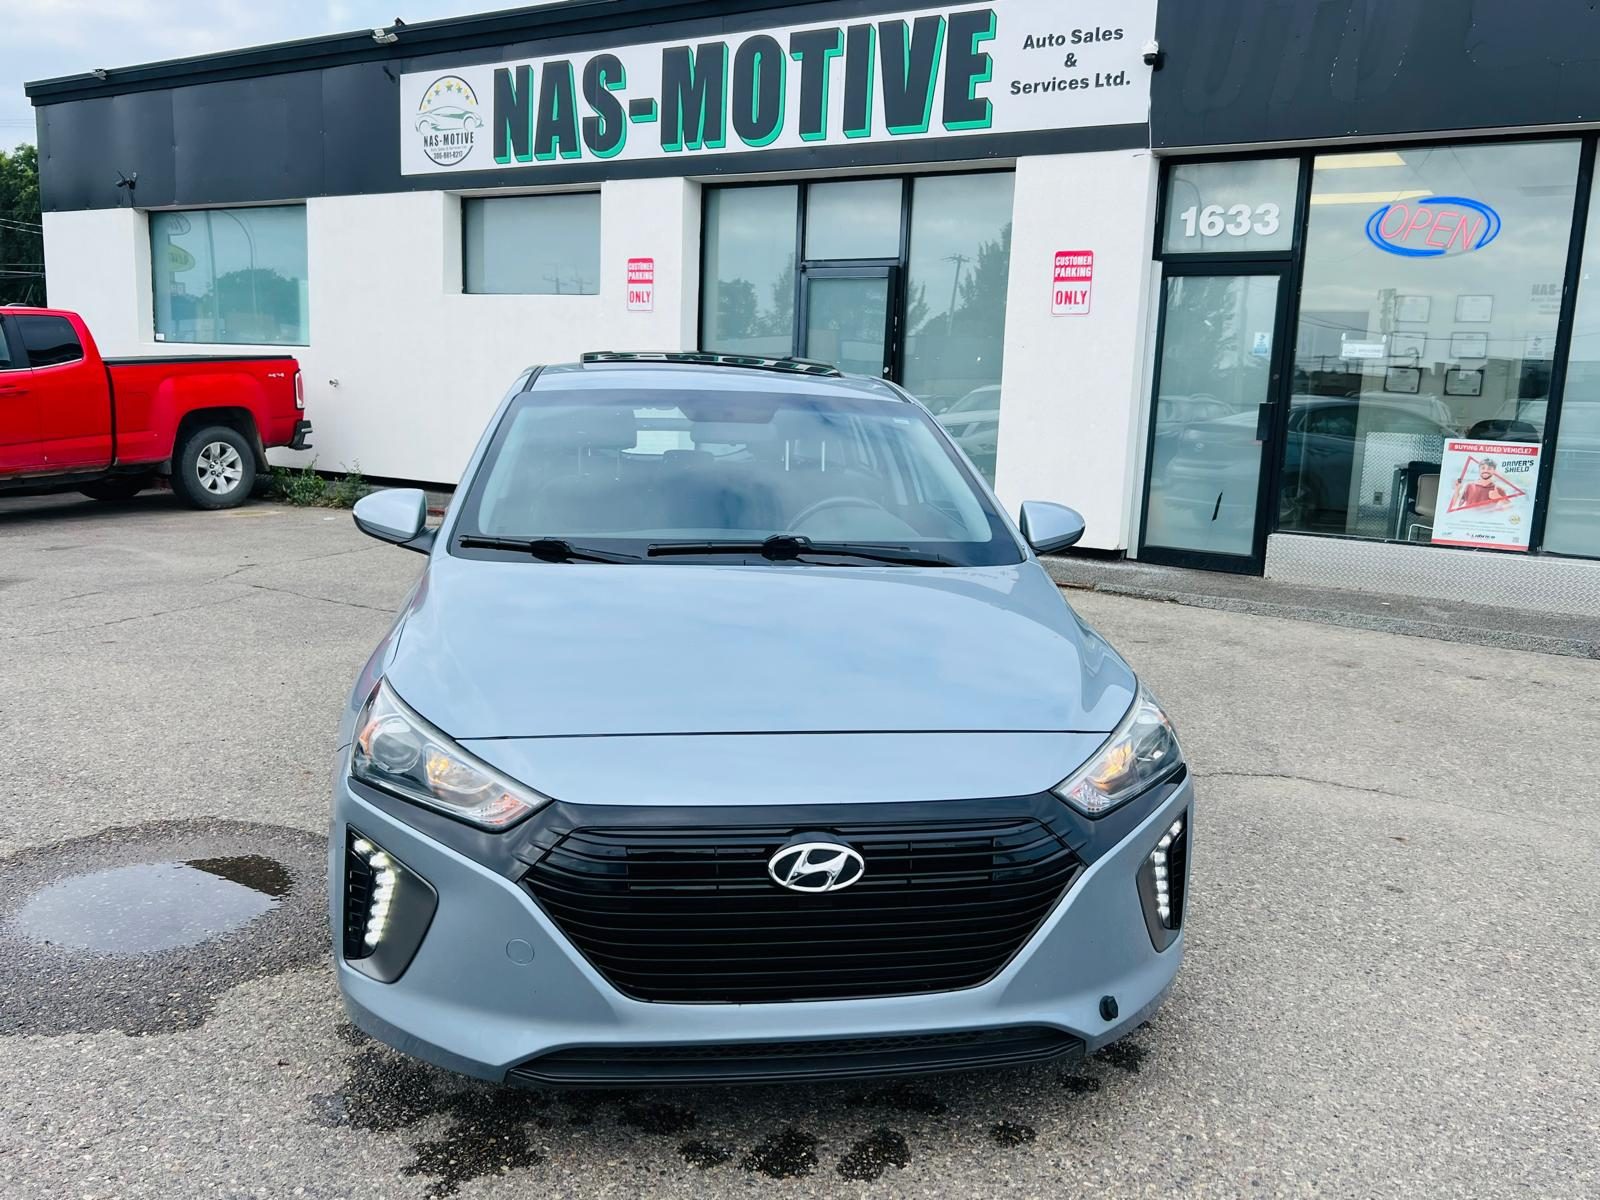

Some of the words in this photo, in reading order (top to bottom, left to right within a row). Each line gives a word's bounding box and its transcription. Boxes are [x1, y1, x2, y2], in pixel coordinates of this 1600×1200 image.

[1023, 34, 1066, 50] Auto
[1070, 27, 1124, 44] Sales
[1064, 52, 1078, 68] &
[494, 9, 997, 164] NAS-MOTIVE
[1010, 77, 1089, 95] Services
[1095, 70, 1131, 88] Ltd.
[423, 132, 474, 147] NAS-MOTIVE
[1181, 203, 1279, 237] 1633
[1380, 204, 1481, 251] OPEN
[1055, 256, 1092, 266] CUSTOMER
[1055, 267, 1092, 277] PARKING
[629, 290, 651, 303] ONLY
[1055, 290, 1088, 305] ONLY
[1502, 460, 1534, 468] DRIVER'S
